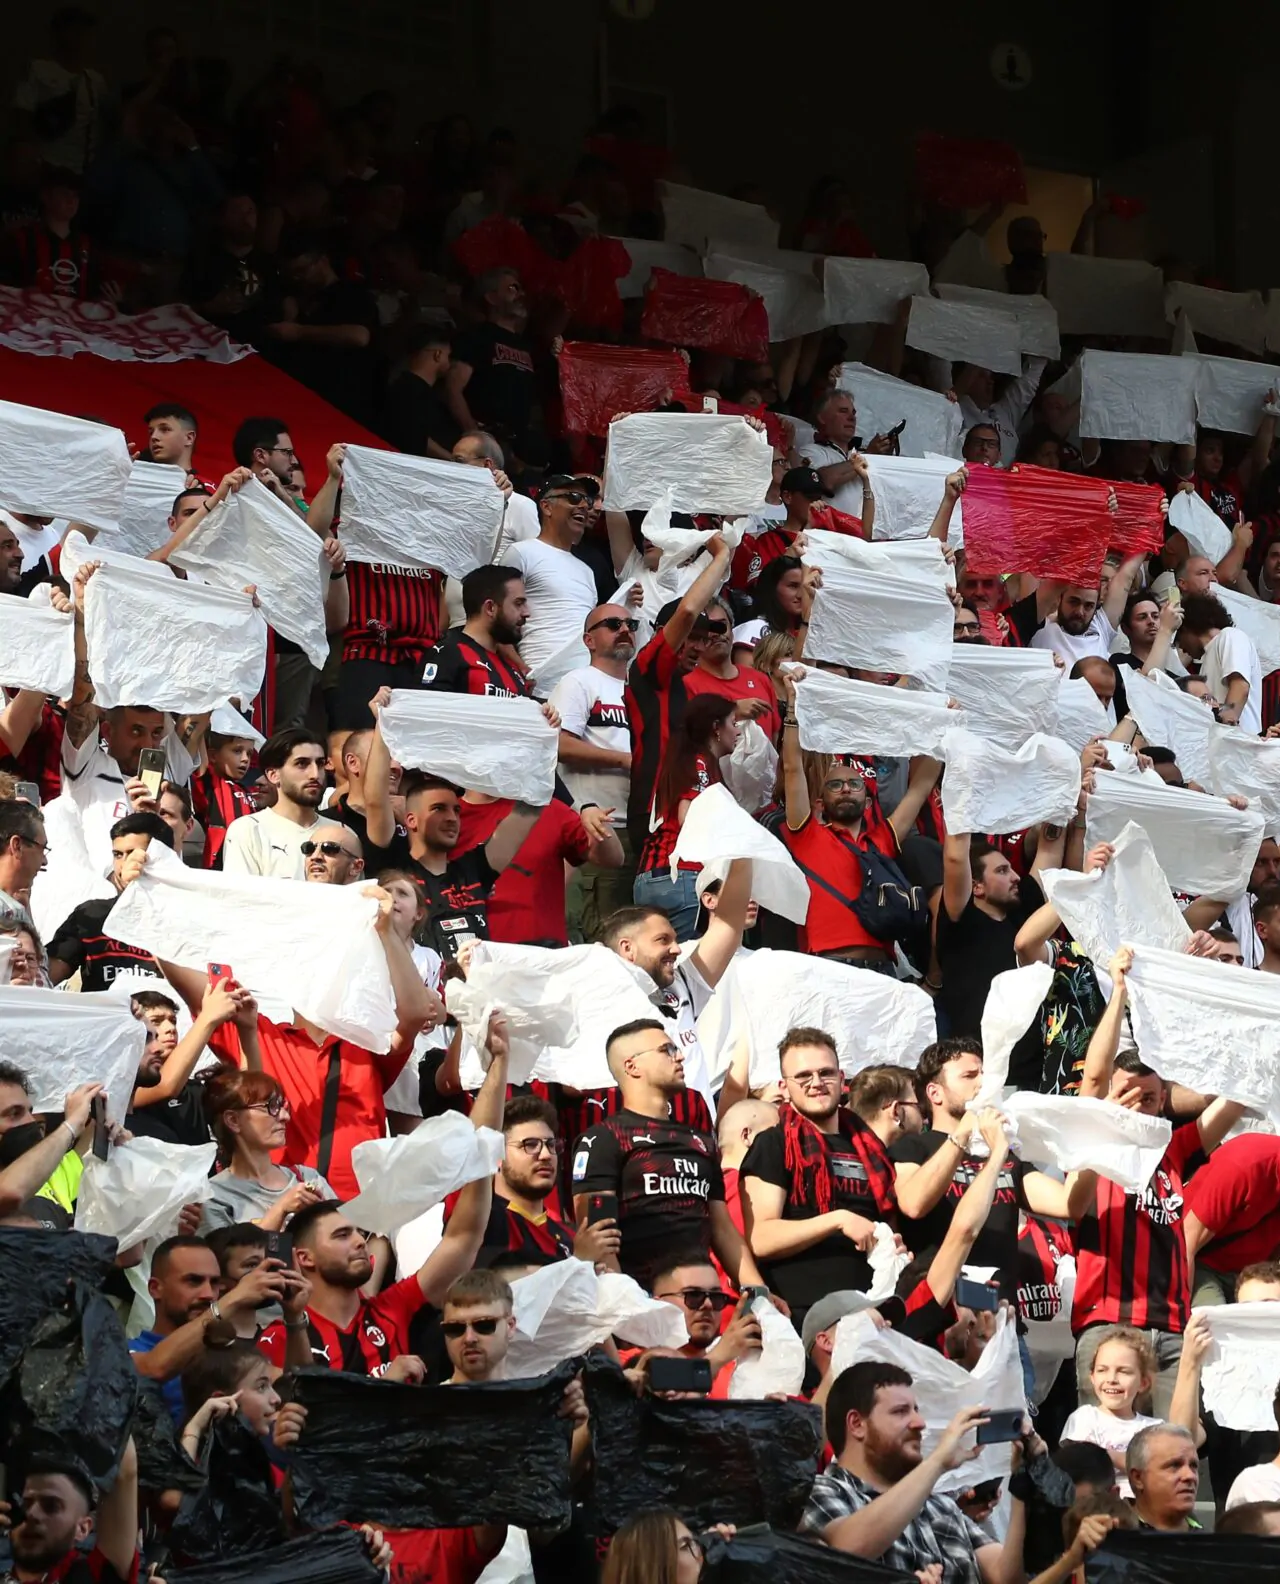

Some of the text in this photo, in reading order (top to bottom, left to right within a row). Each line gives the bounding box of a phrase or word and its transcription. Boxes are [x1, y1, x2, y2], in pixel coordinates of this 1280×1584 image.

[484, 682, 519, 699] Emir
[600, 708, 629, 725] MIL
[673, 1158, 698, 1177] Fly
